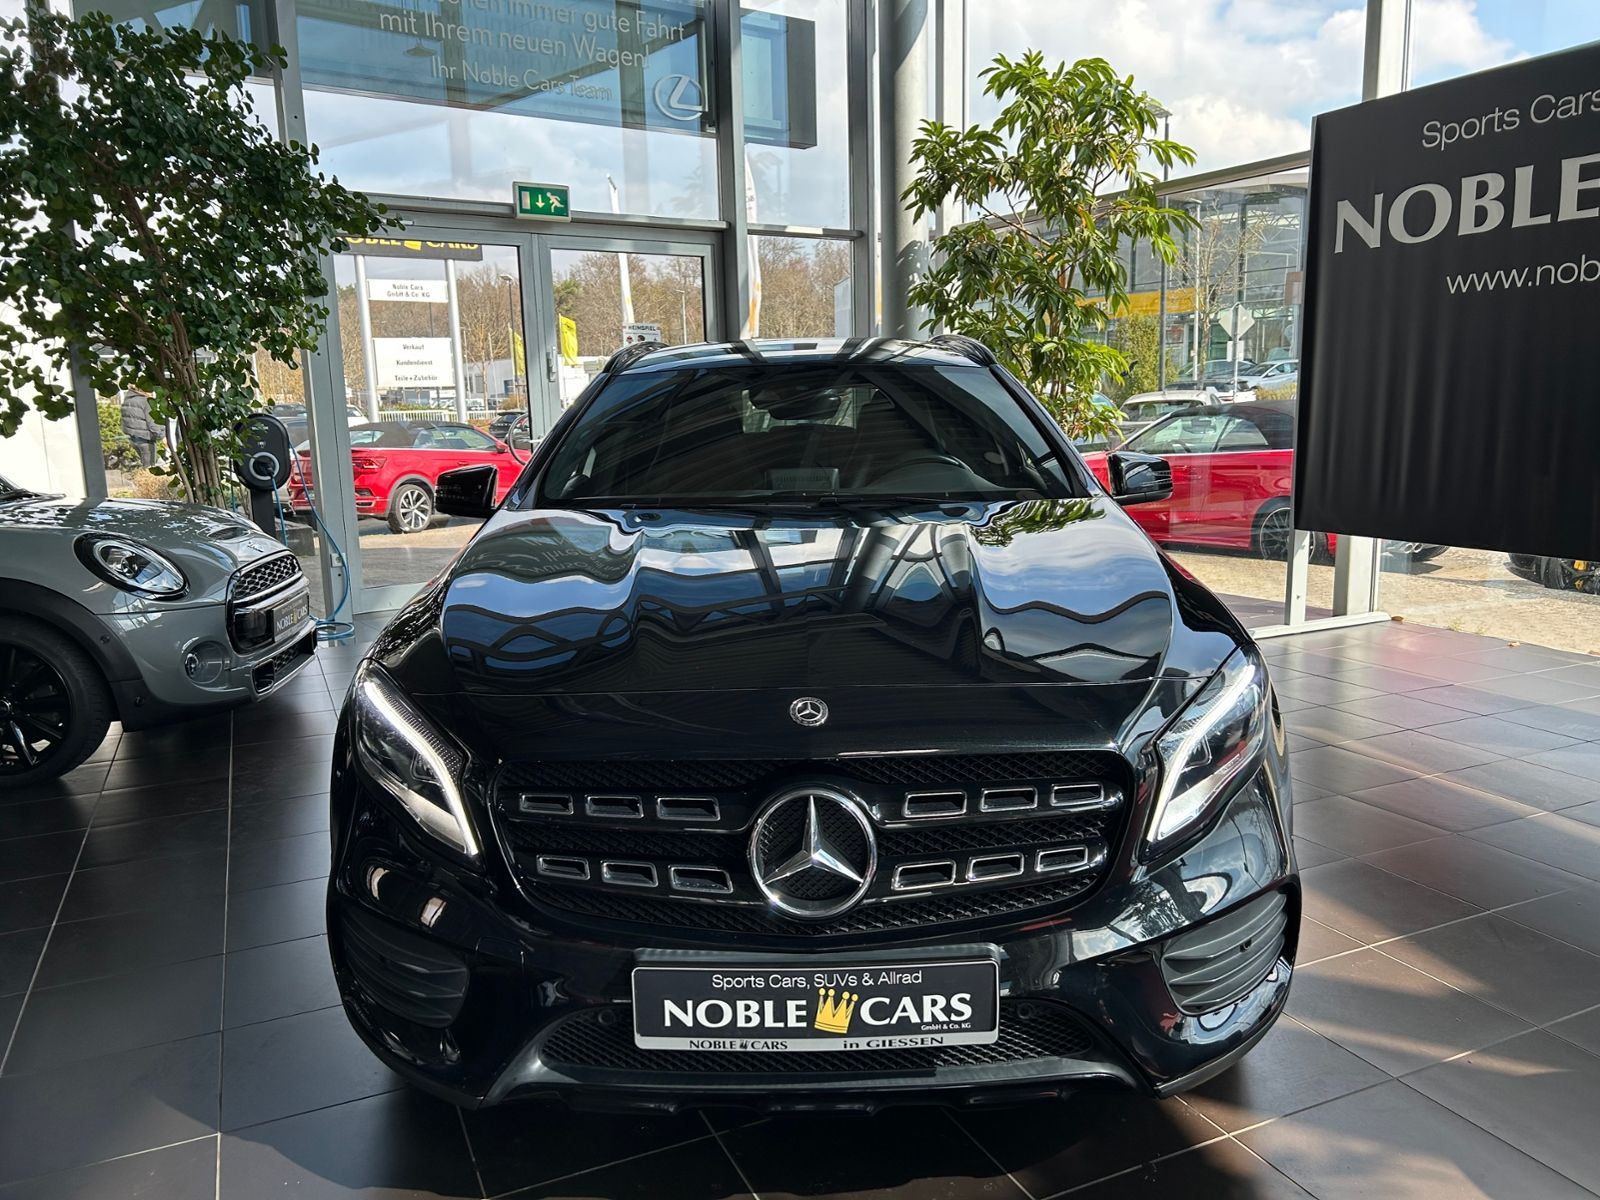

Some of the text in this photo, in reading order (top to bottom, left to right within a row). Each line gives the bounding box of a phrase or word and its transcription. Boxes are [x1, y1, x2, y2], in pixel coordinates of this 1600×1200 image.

[380, 9, 650, 69] mit Ihrem neuen Wagen!
[584, 10, 630, 33] gute
[635, 9, 685, 41] Fahrt
[432, 55, 613, 101] Ihr Noble Cars Team
[1421, 106, 1520, 151] Sports
[1334, 152, 1600, 254] NOBLE
[1446, 254, 1600, 295] www.nob
[712, 970, 922, 991] Sports Cars, SUVs & Allrad
[663, 993, 972, 1028] NOBLE CARS
[921, 1023, 942, 1031] GmbH
[689, 1036, 944, 1050] NOBLE CARS in GIESSEN
